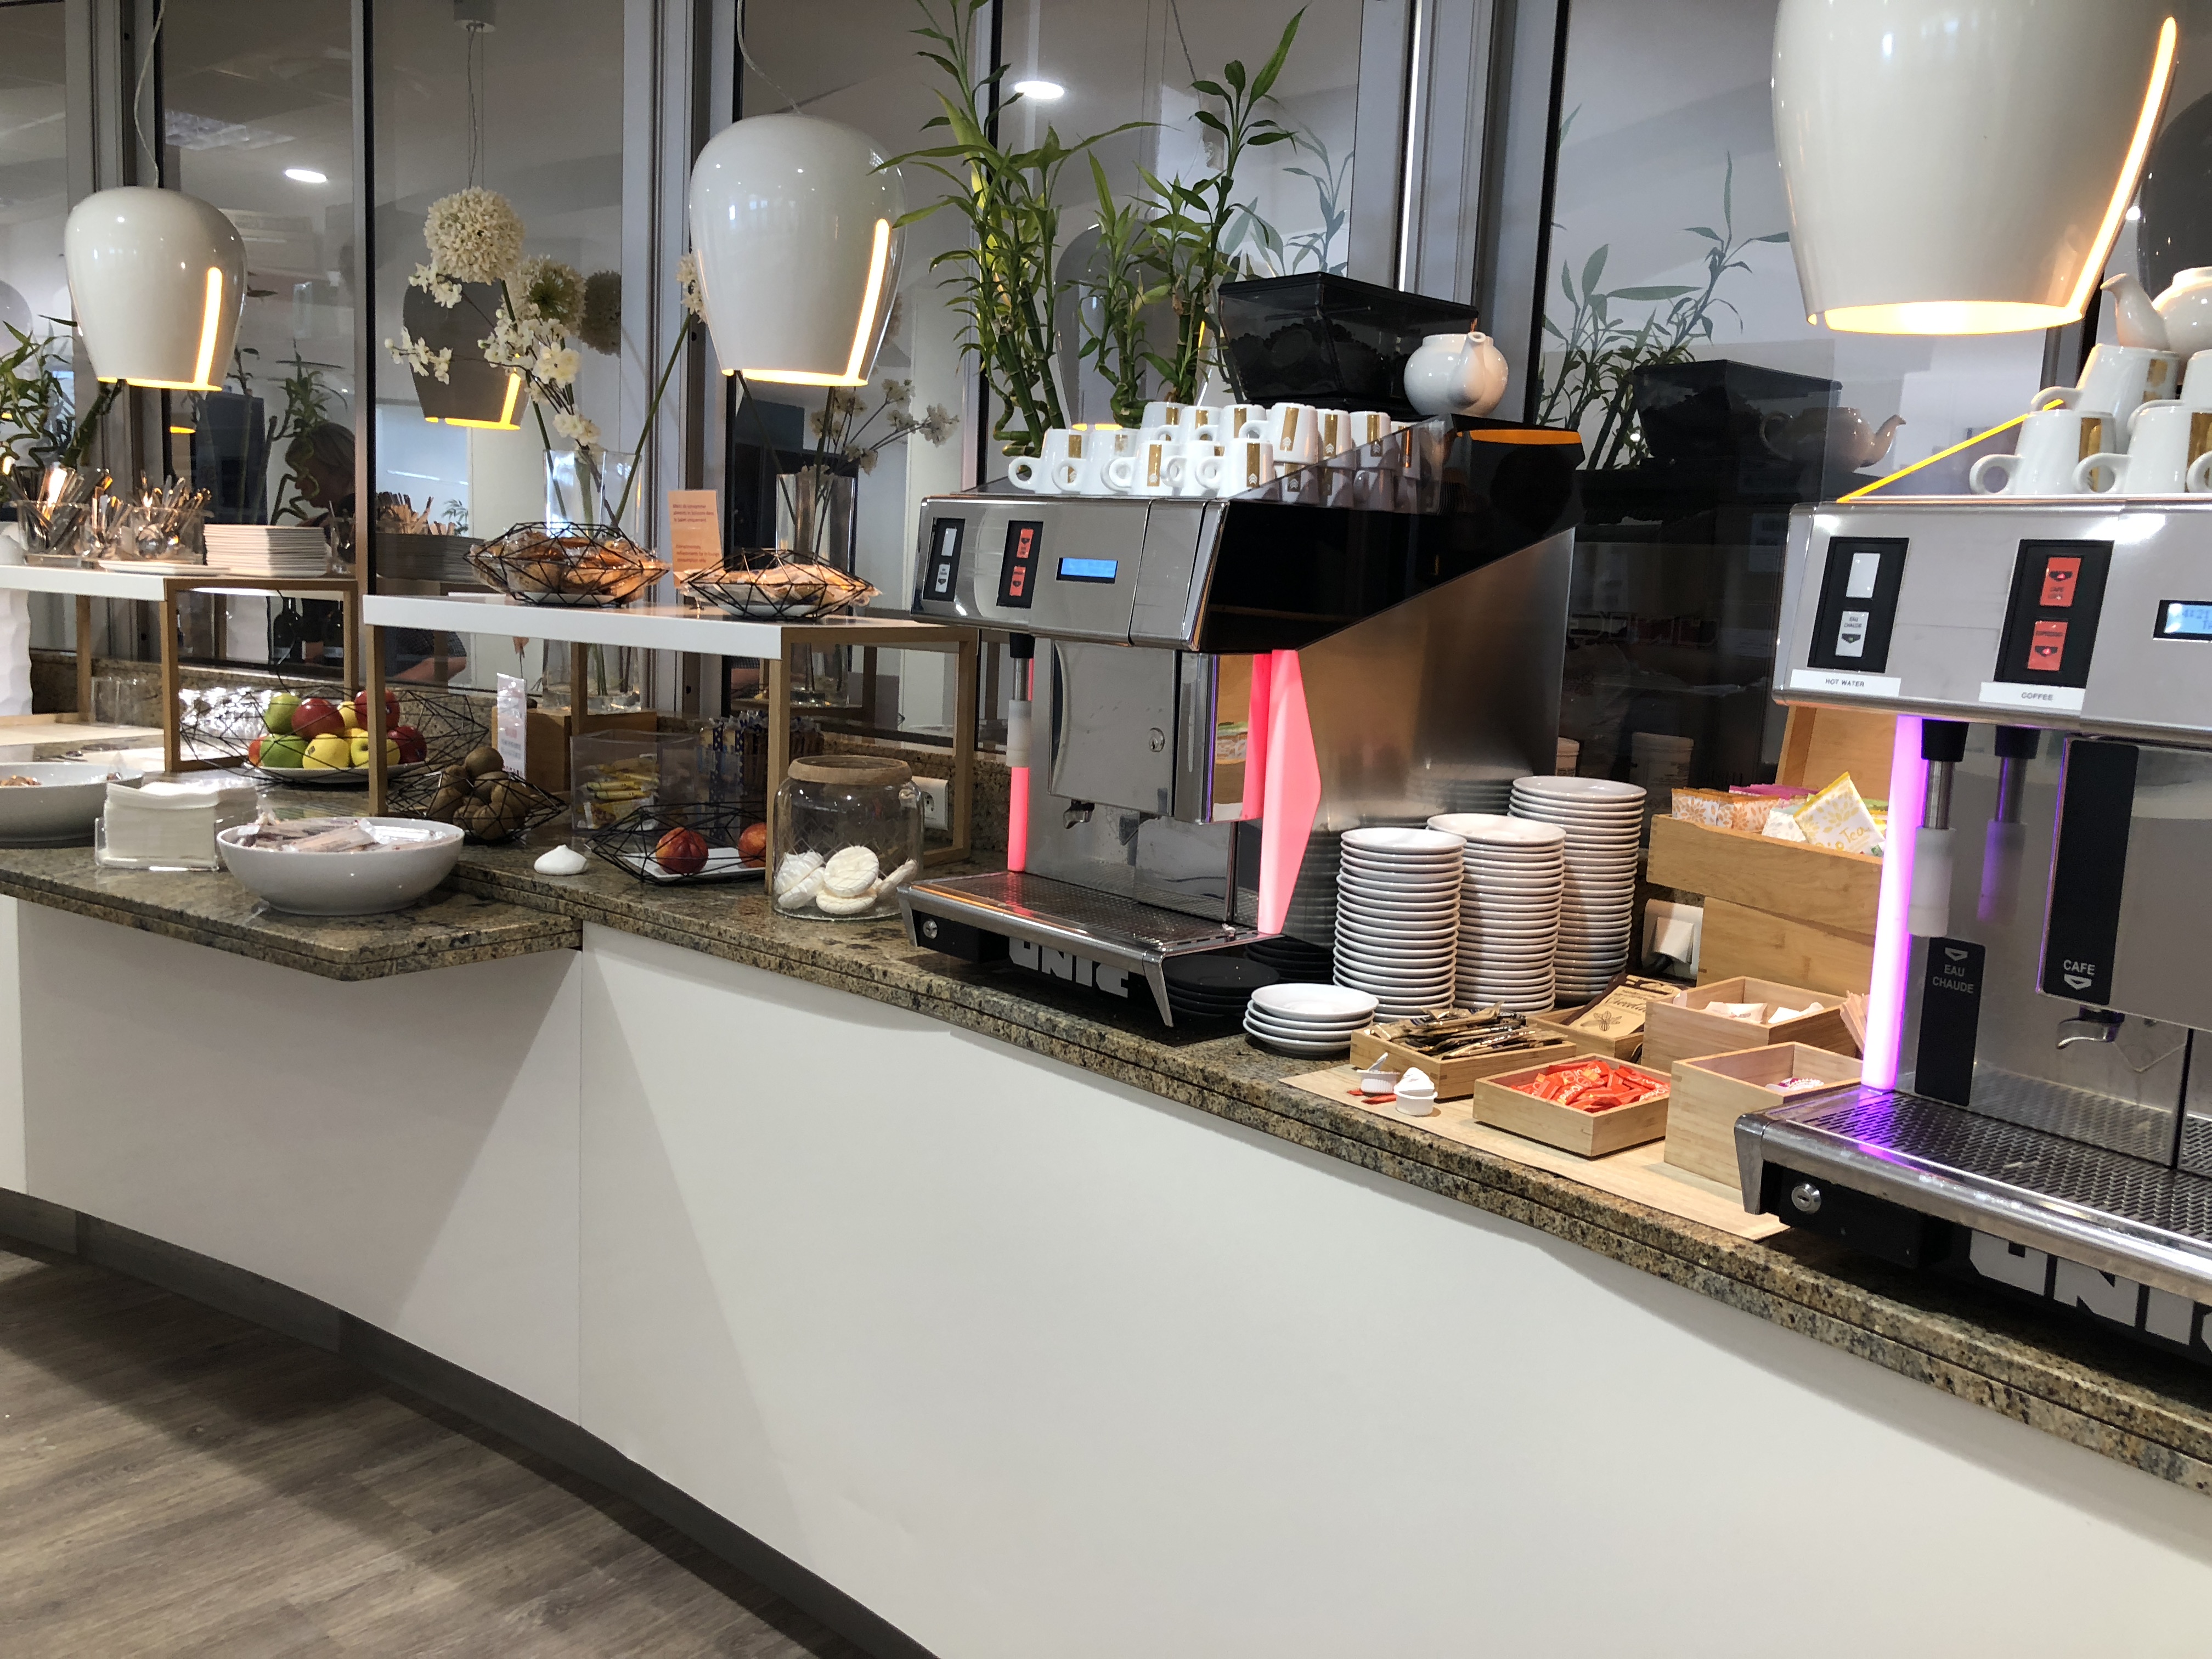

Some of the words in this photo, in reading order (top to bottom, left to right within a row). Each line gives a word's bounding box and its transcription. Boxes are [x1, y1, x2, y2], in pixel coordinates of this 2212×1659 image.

[2021, 692, 2053, 701] COFFEE
[1944, 964, 1965, 977] EAU
[2063, 959, 2096, 976] CAFE
[1932, 976, 1974, 994] CHAUDE
[1970, 1229, 2212, 1355] UNI
